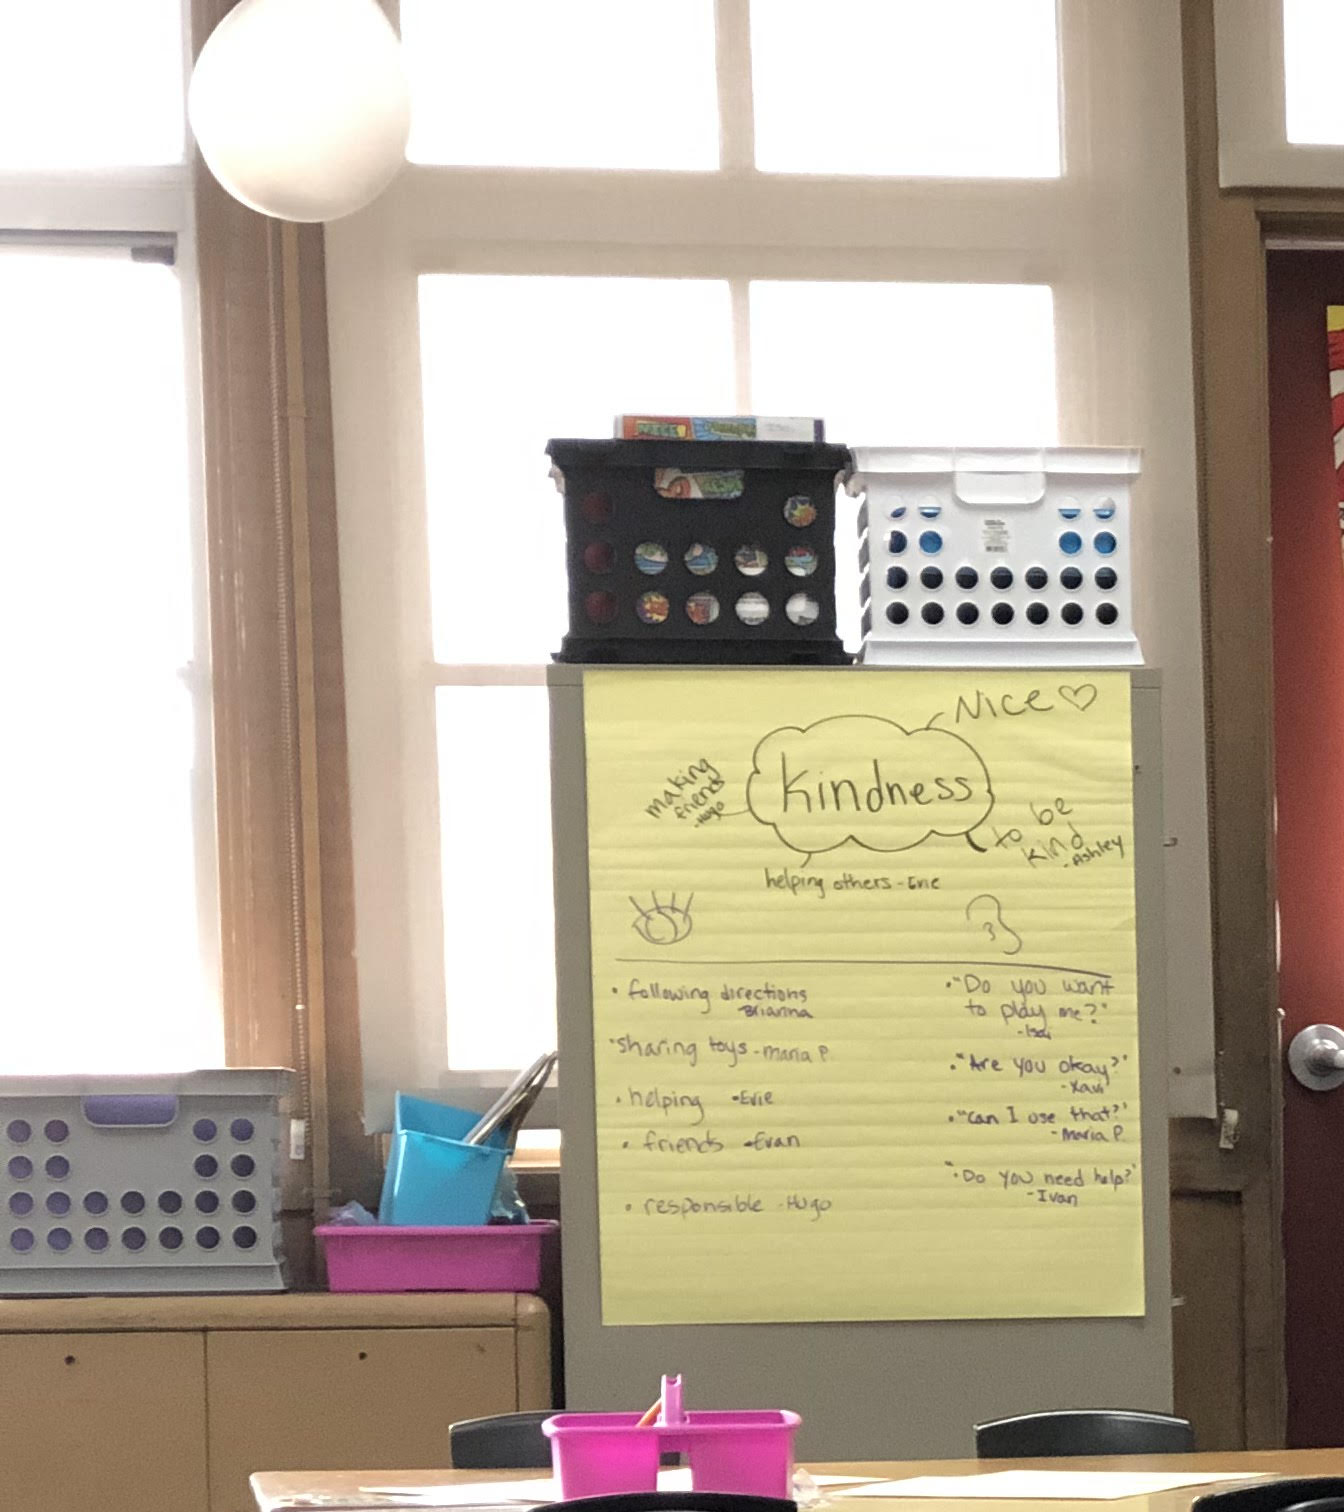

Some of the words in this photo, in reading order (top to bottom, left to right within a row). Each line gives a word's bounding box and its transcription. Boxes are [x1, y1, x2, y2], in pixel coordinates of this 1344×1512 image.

[955, 690, 1055, 724] Nice
[764, 867, 826, 899] helping
[833, 873, 892, 890] others
[628, 978, 711, 1014] following
[720, 982, 807, 1002] directions
[1010, 979, 1047, 998] you
[1062, 980, 1115, 996] want
[964, 999, 987, 1017] to
[1000, 1000, 1049, 1028] play
[616, 1034, 698, 1068] sharing
[708, 1036, 747, 1068] toys
[1013, 1058, 1046, 1078] you
[628, 1088, 705, 1127] helping
[1028, 1111, 1056, 1125] use
[643, 1130, 725, 1154] friends
[998, 1169, 1034, 1189] you
[1044, 1168, 1084, 1187] need
[643, 1195, 764, 1220] responsible
